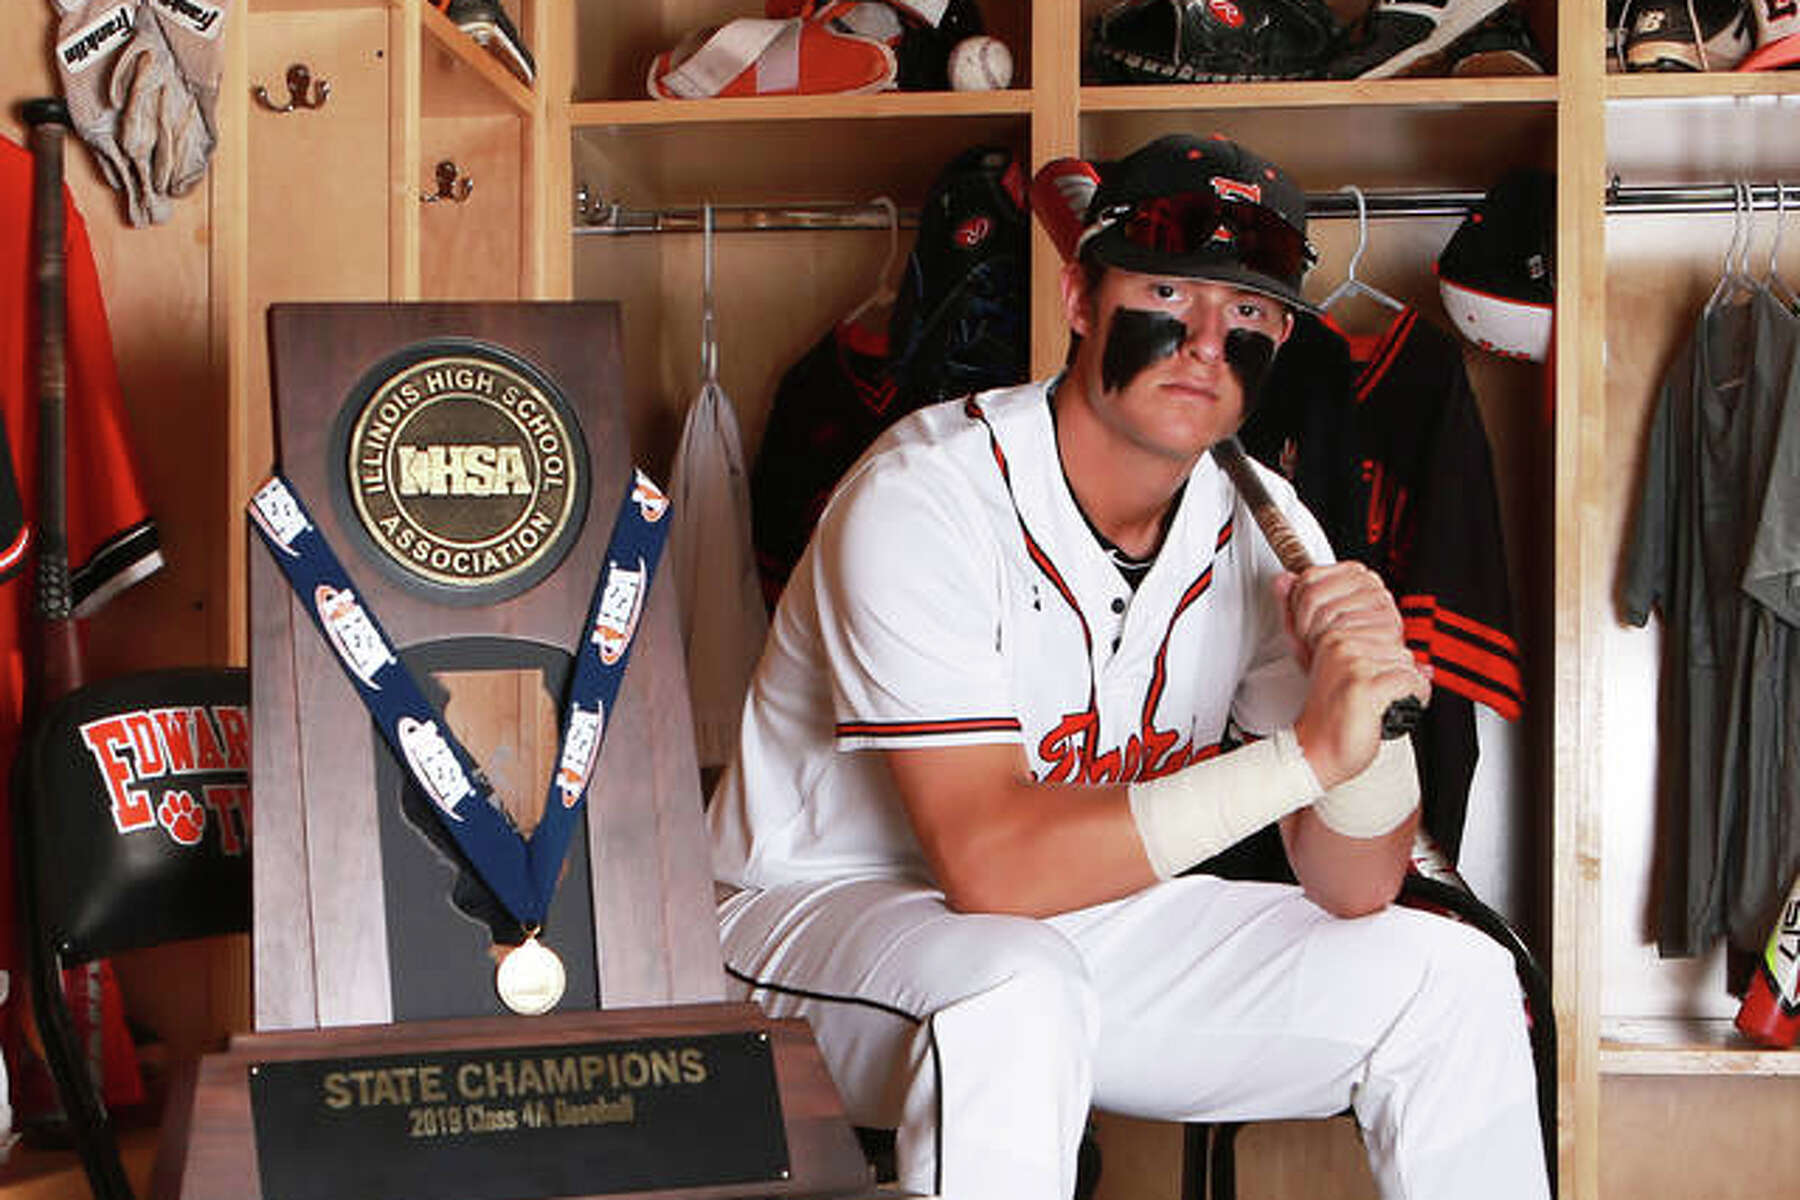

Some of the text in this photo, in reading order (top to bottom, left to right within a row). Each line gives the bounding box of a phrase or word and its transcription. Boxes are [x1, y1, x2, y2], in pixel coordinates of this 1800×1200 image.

[64, 8, 137, 65] Franklin
[361, 369, 565, 494] ILLINOIS HIGH SCHOOL
[379, 511, 553, 573] ASSOCIATION
[324, 1047, 707, 1109] STATE CHAMPIONS
[409, 1106, 463, 1137] 2019
[467, 1103, 519, 1132] Class
